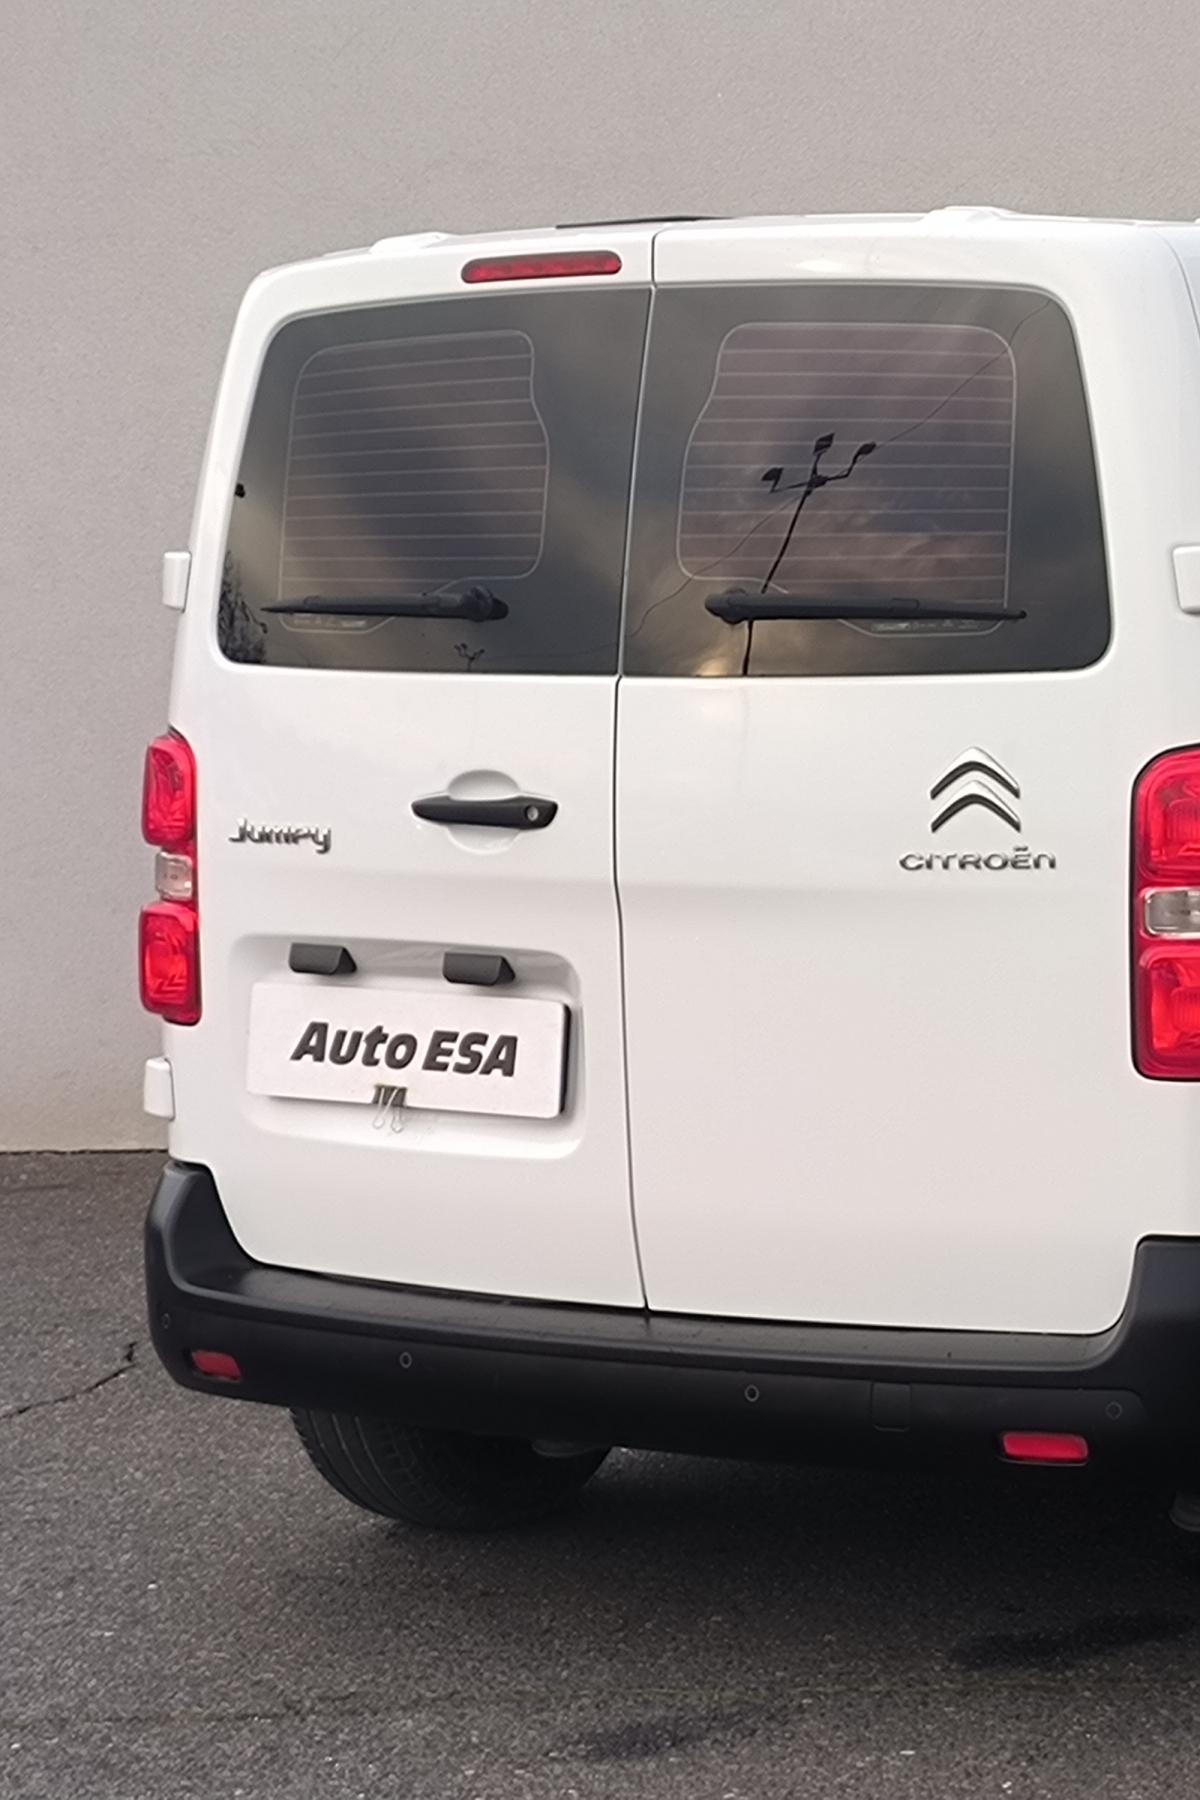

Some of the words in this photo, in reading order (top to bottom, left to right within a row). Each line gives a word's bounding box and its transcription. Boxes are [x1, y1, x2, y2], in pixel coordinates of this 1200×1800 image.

[228, 817, 332, 855] Jumpy
[289, 1020, 418, 1070] Auto
[421, 1029, 519, 1078] ESA
